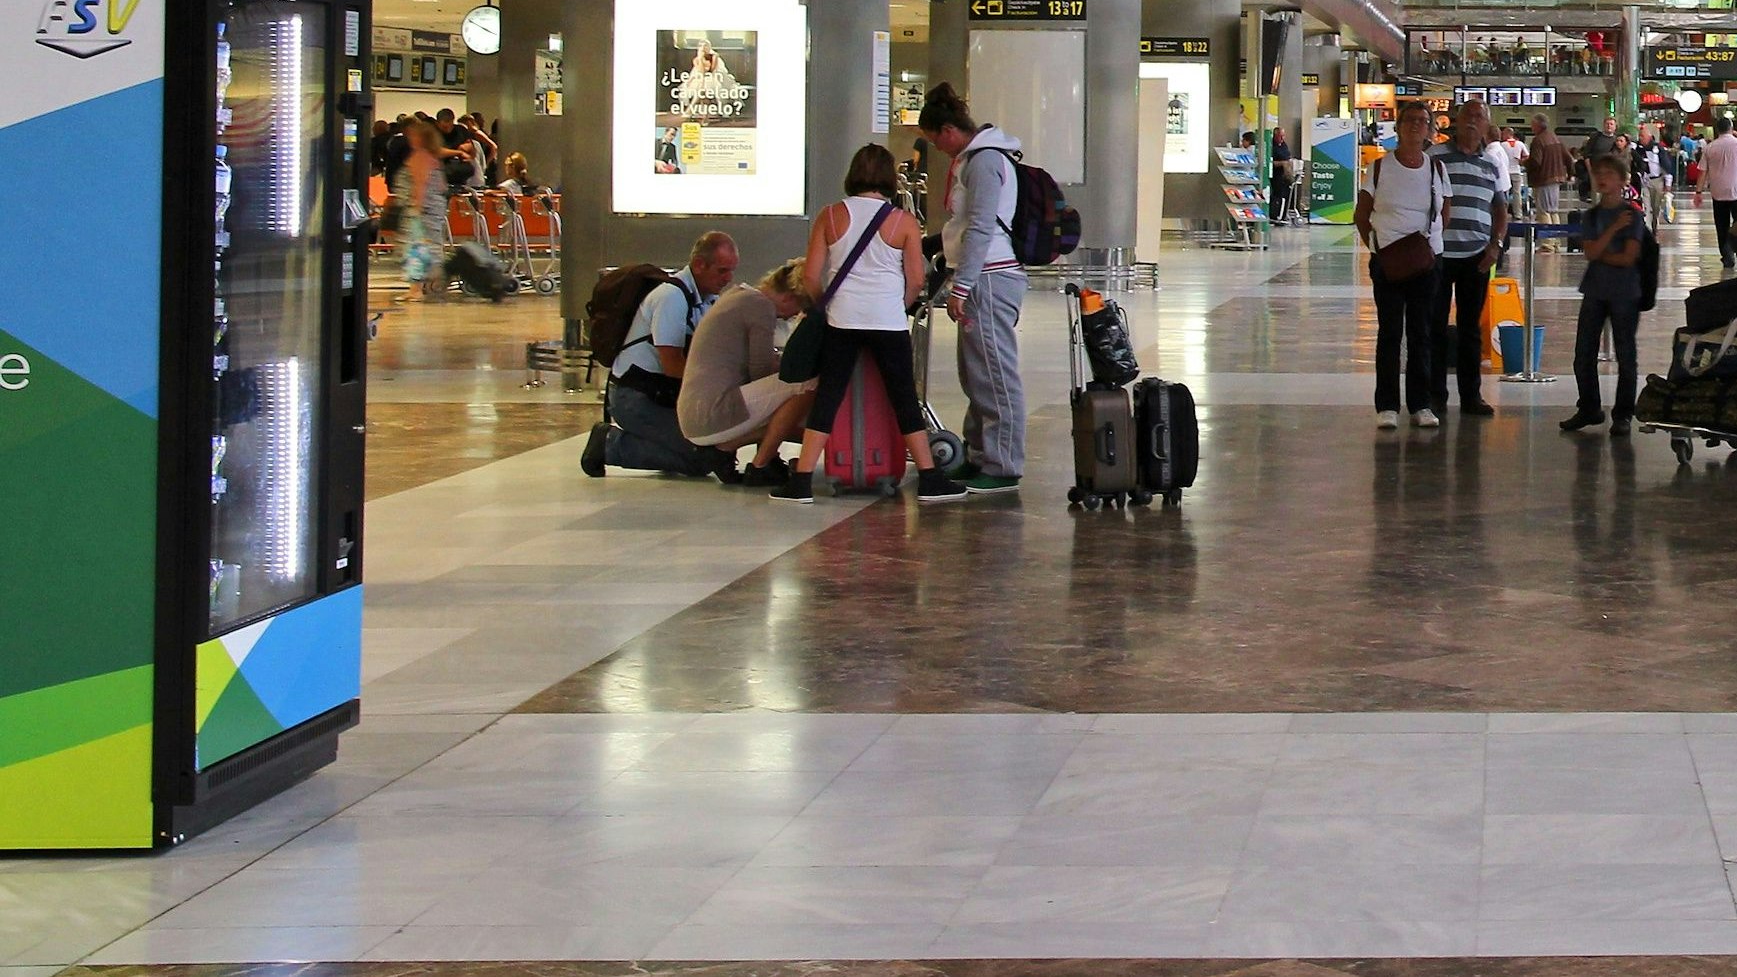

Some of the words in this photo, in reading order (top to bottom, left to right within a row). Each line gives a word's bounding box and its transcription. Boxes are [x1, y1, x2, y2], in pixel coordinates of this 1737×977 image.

[1048, 0, 1061, 15] 13
[1070, 0, 1083, 15] 17
[1198, 41, 1208, 53] 22
[661, 67, 690, 87] ¿Le
[670, 87, 749, 99] cancelado
[670, 102, 686, 115] el
[690, 101, 744, 116] vuelo?
[718, 142, 753, 150] derechos
[1312, 162, 1340, 170] Choose
[1312, 172, 1334, 180] Taste
[1312, 181, 1332, 191] Enjoy
